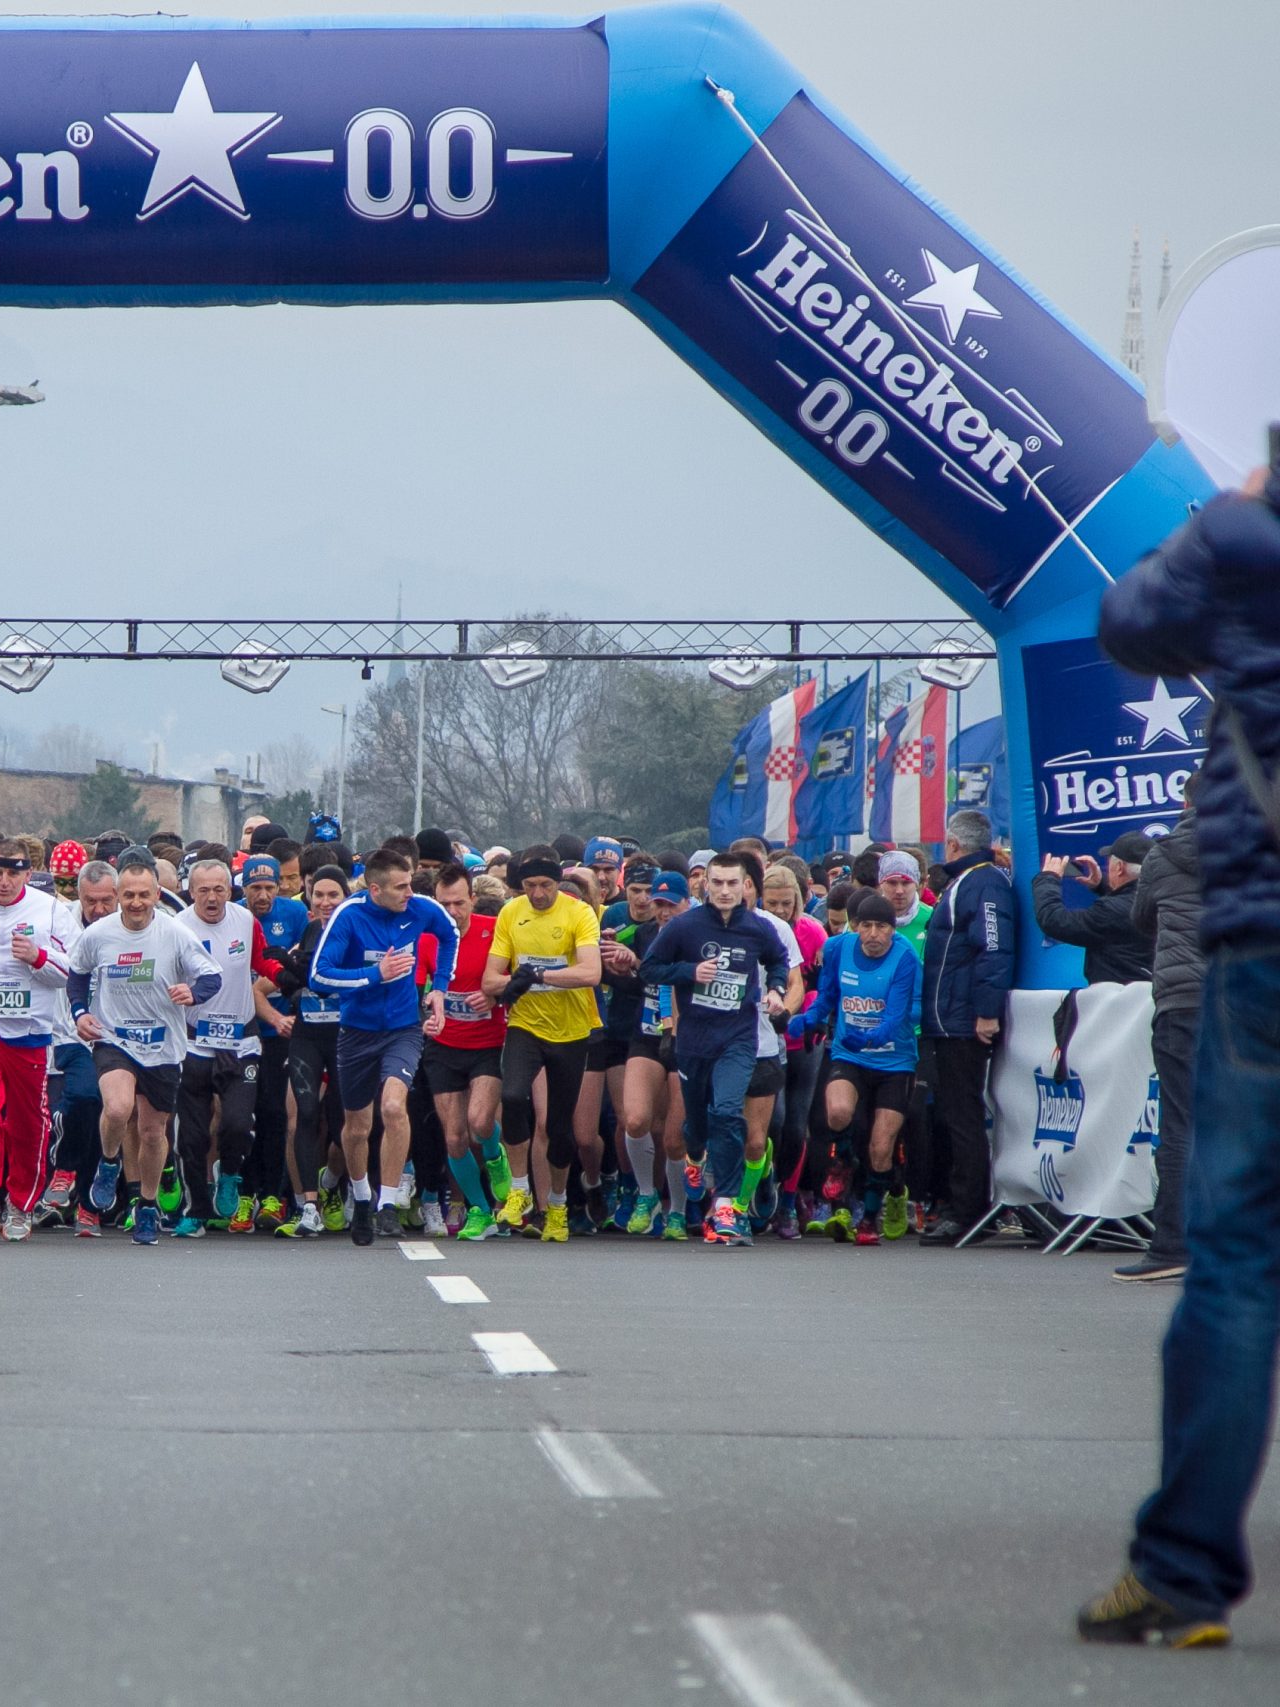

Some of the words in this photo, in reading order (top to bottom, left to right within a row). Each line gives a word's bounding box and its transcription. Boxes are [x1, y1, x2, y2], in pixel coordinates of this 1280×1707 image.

[344, 107, 497, 220] 0.0
[884, 269, 907, 291] EST.
[964, 336, 989, 359] 1873
[754, 233, 1023, 484] Heineken
[798, 378, 890, 466] 0.0
[1117, 736, 1137, 746] EST.
[1054, 758, 1205, 816] Heine
[984, 901, 999, 951] LEGEA
[119, 955, 141, 963] Milan
[134, 965, 152, 977] 365
[704, 981, 740, 1001] 1068
[208, 1023, 235, 1039] 592
